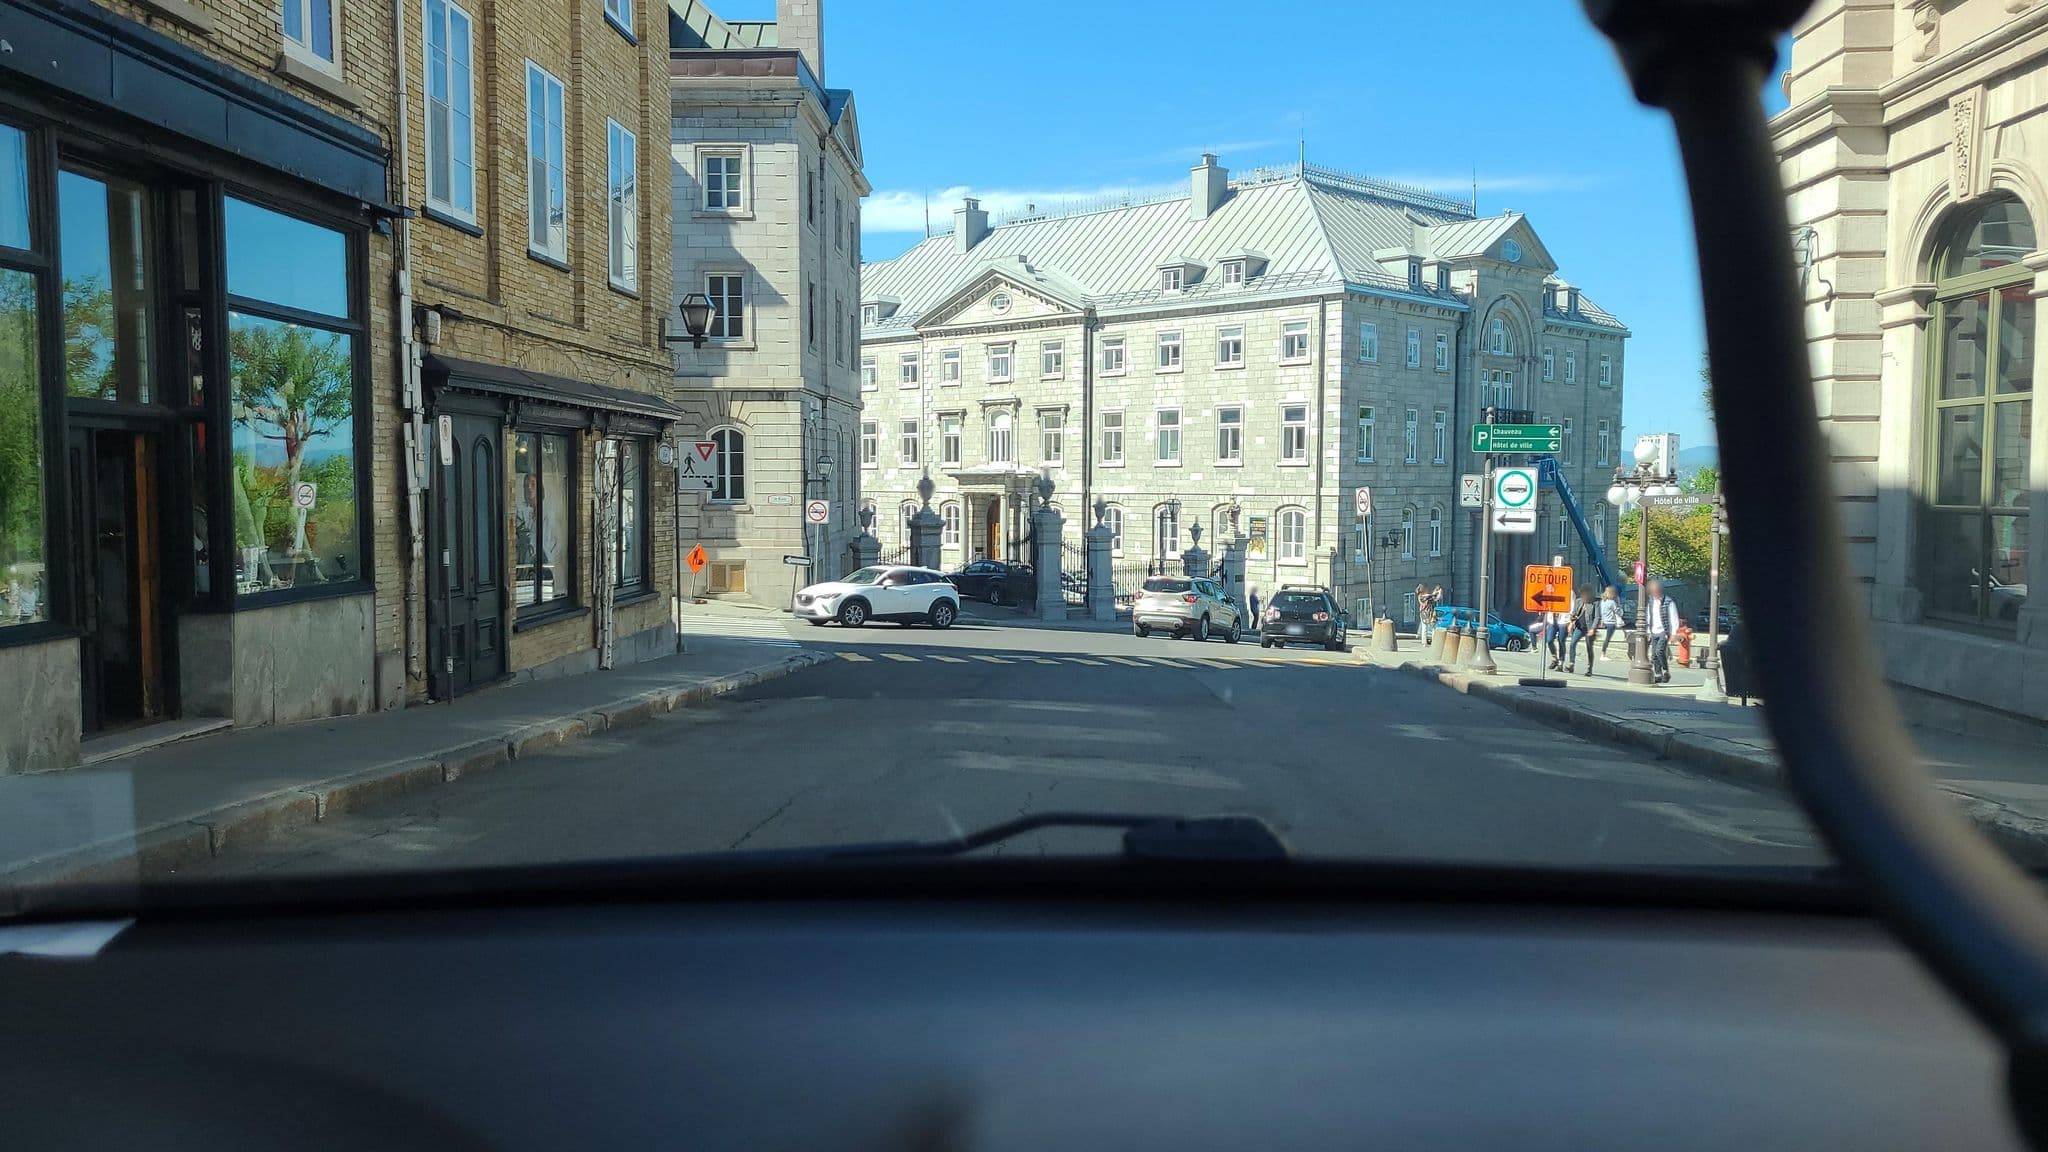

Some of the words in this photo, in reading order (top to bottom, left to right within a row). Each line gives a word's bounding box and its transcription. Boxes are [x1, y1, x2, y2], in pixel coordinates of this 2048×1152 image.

[1478, 431, 1488, 446] P
[1654, 496, 1673, 505] Hôtel
[1674, 496, 1683, 504] de
[1684, 496, 1700, 504] ville
